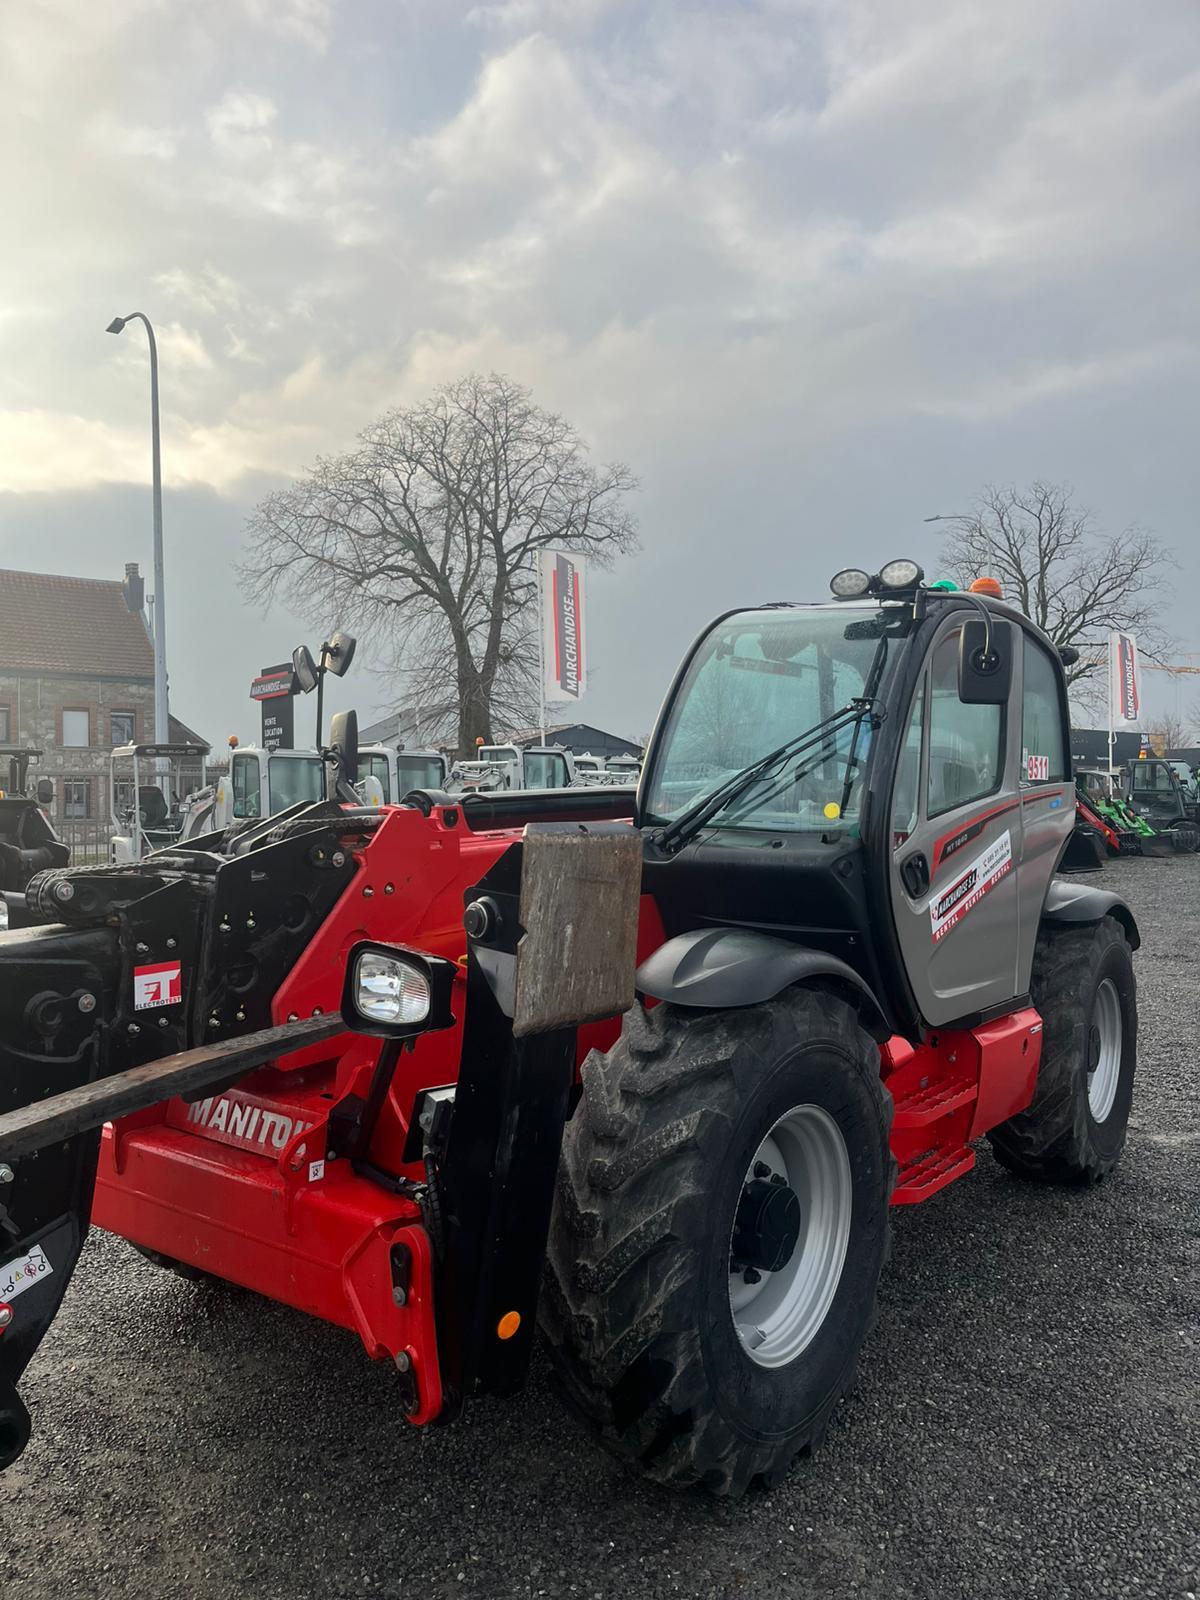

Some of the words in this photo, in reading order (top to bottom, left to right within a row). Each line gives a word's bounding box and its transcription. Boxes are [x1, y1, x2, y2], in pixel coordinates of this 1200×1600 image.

[564, 596, 578, 692] MARCHANDISE
[1125, 660, 1136, 719] MARCHANDISE
[264, 717, 276, 726] VENTE
[264, 728, 283, 737] LOCATION
[1028, 756, 1048, 779] 9511
[935, 914, 959, 941] RENTAL
[965, 887, 986, 912] RENTAL
[991, 862, 1010, 886] RENTAL
[135, 996, 181, 1010] ELECTROTEST
